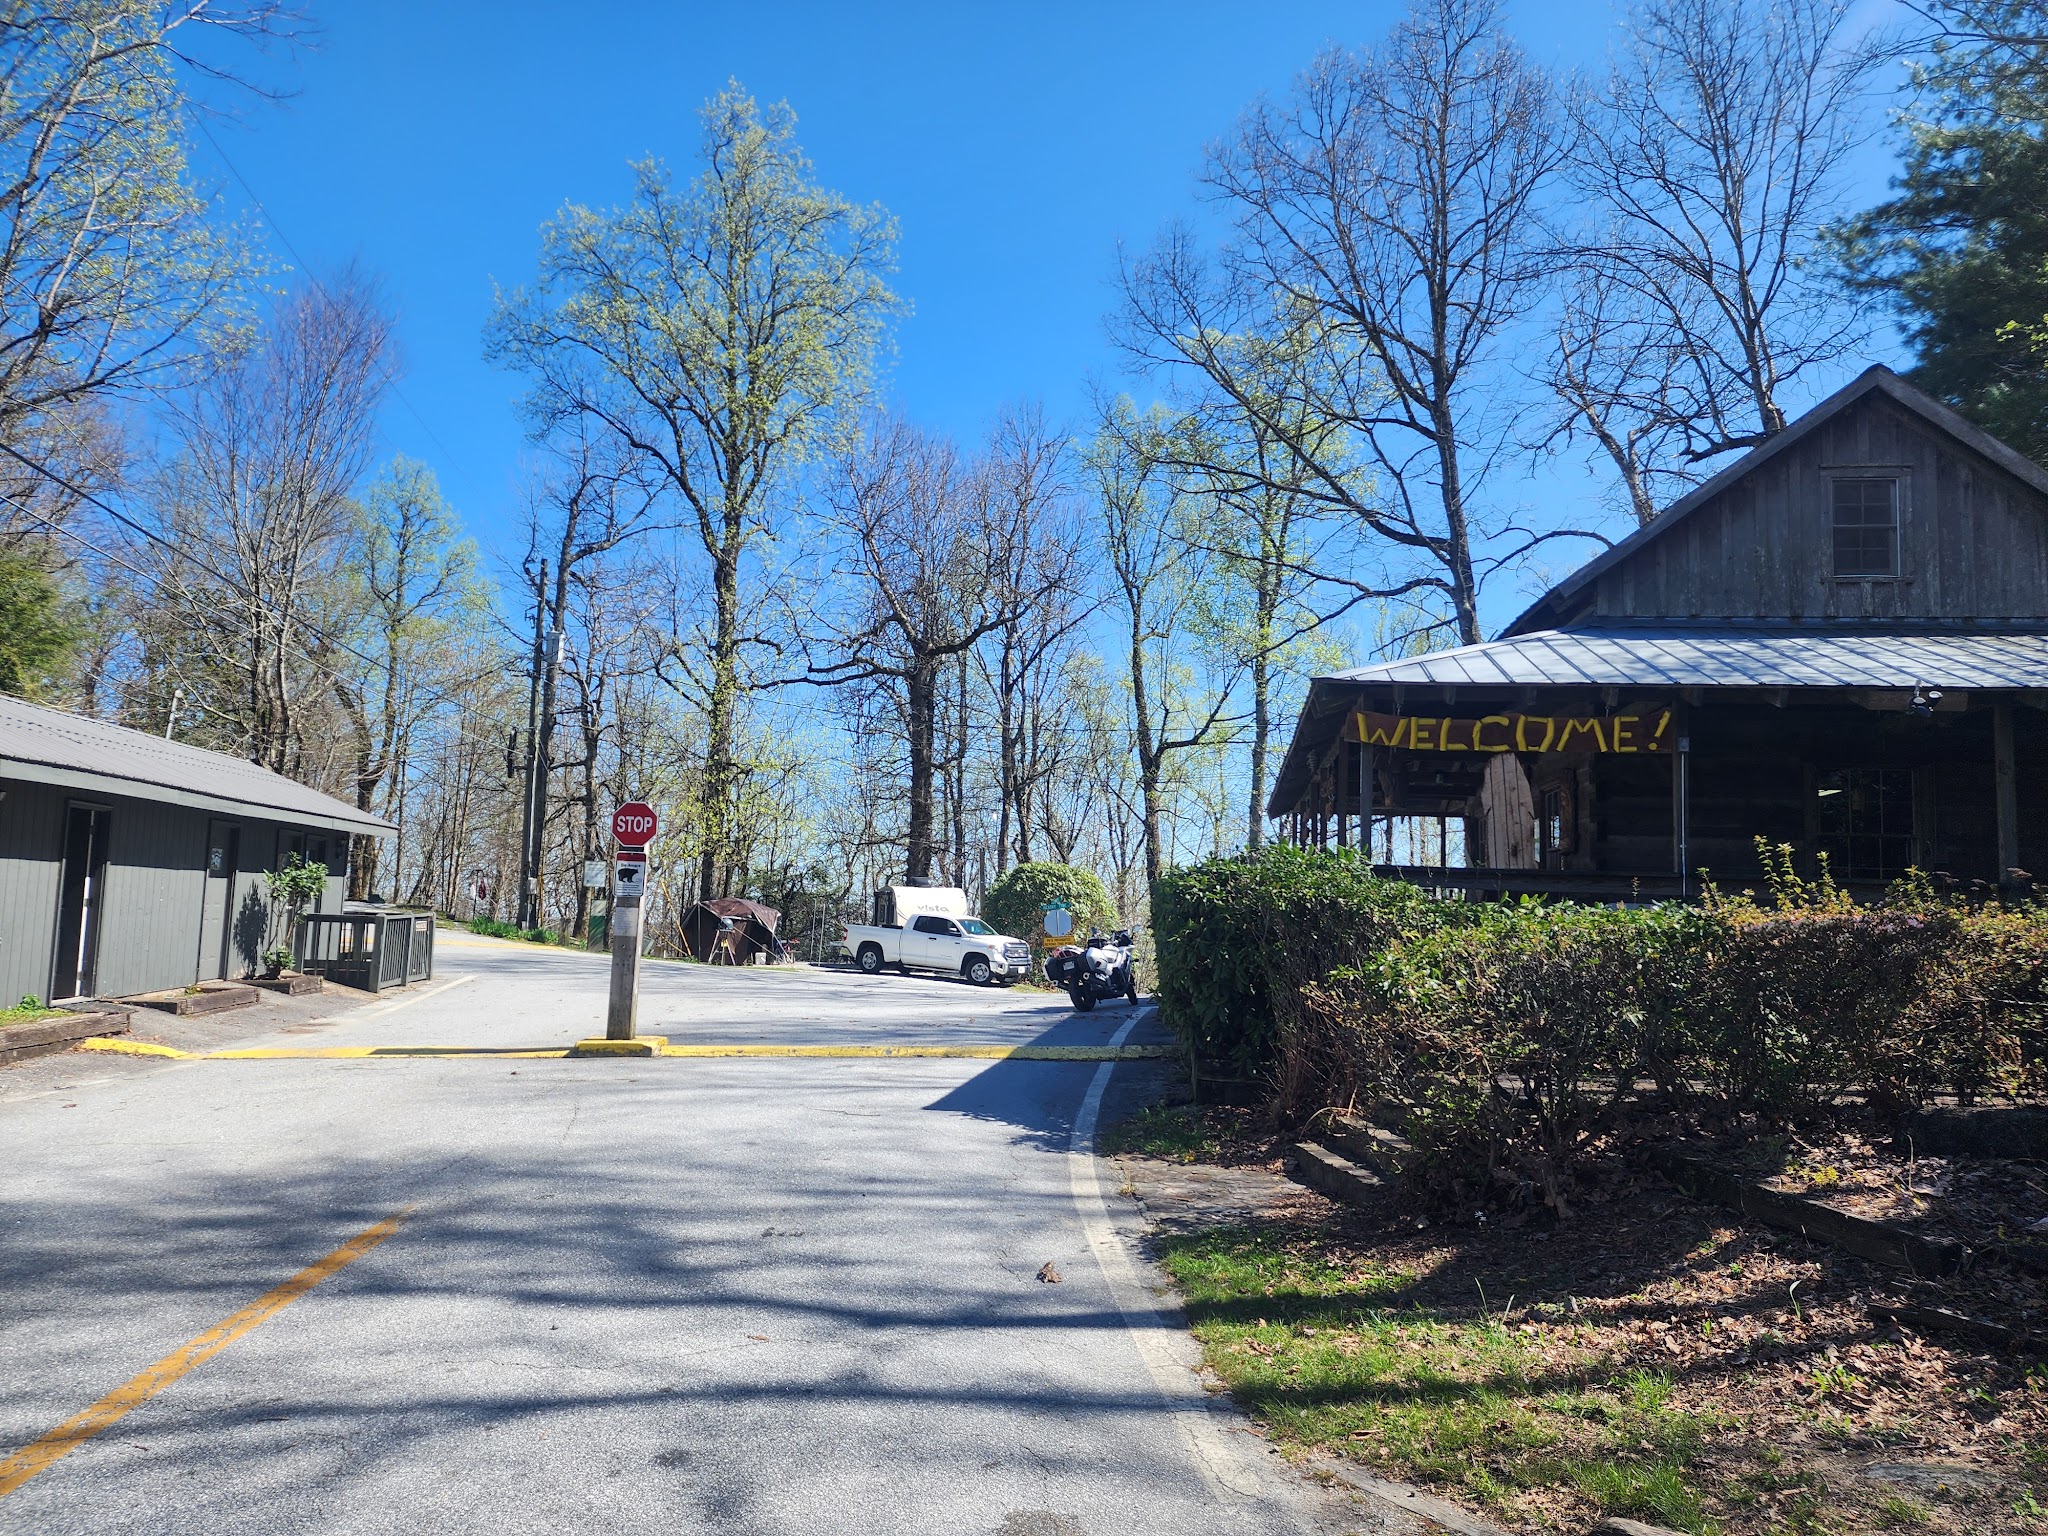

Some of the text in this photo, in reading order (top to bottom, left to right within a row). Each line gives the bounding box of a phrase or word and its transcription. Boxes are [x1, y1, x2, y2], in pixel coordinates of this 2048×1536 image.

[1357, 711, 1671, 753] WELCOME!
[617, 815, 653, 833] STOP
[917, 904, 950, 913] vista
